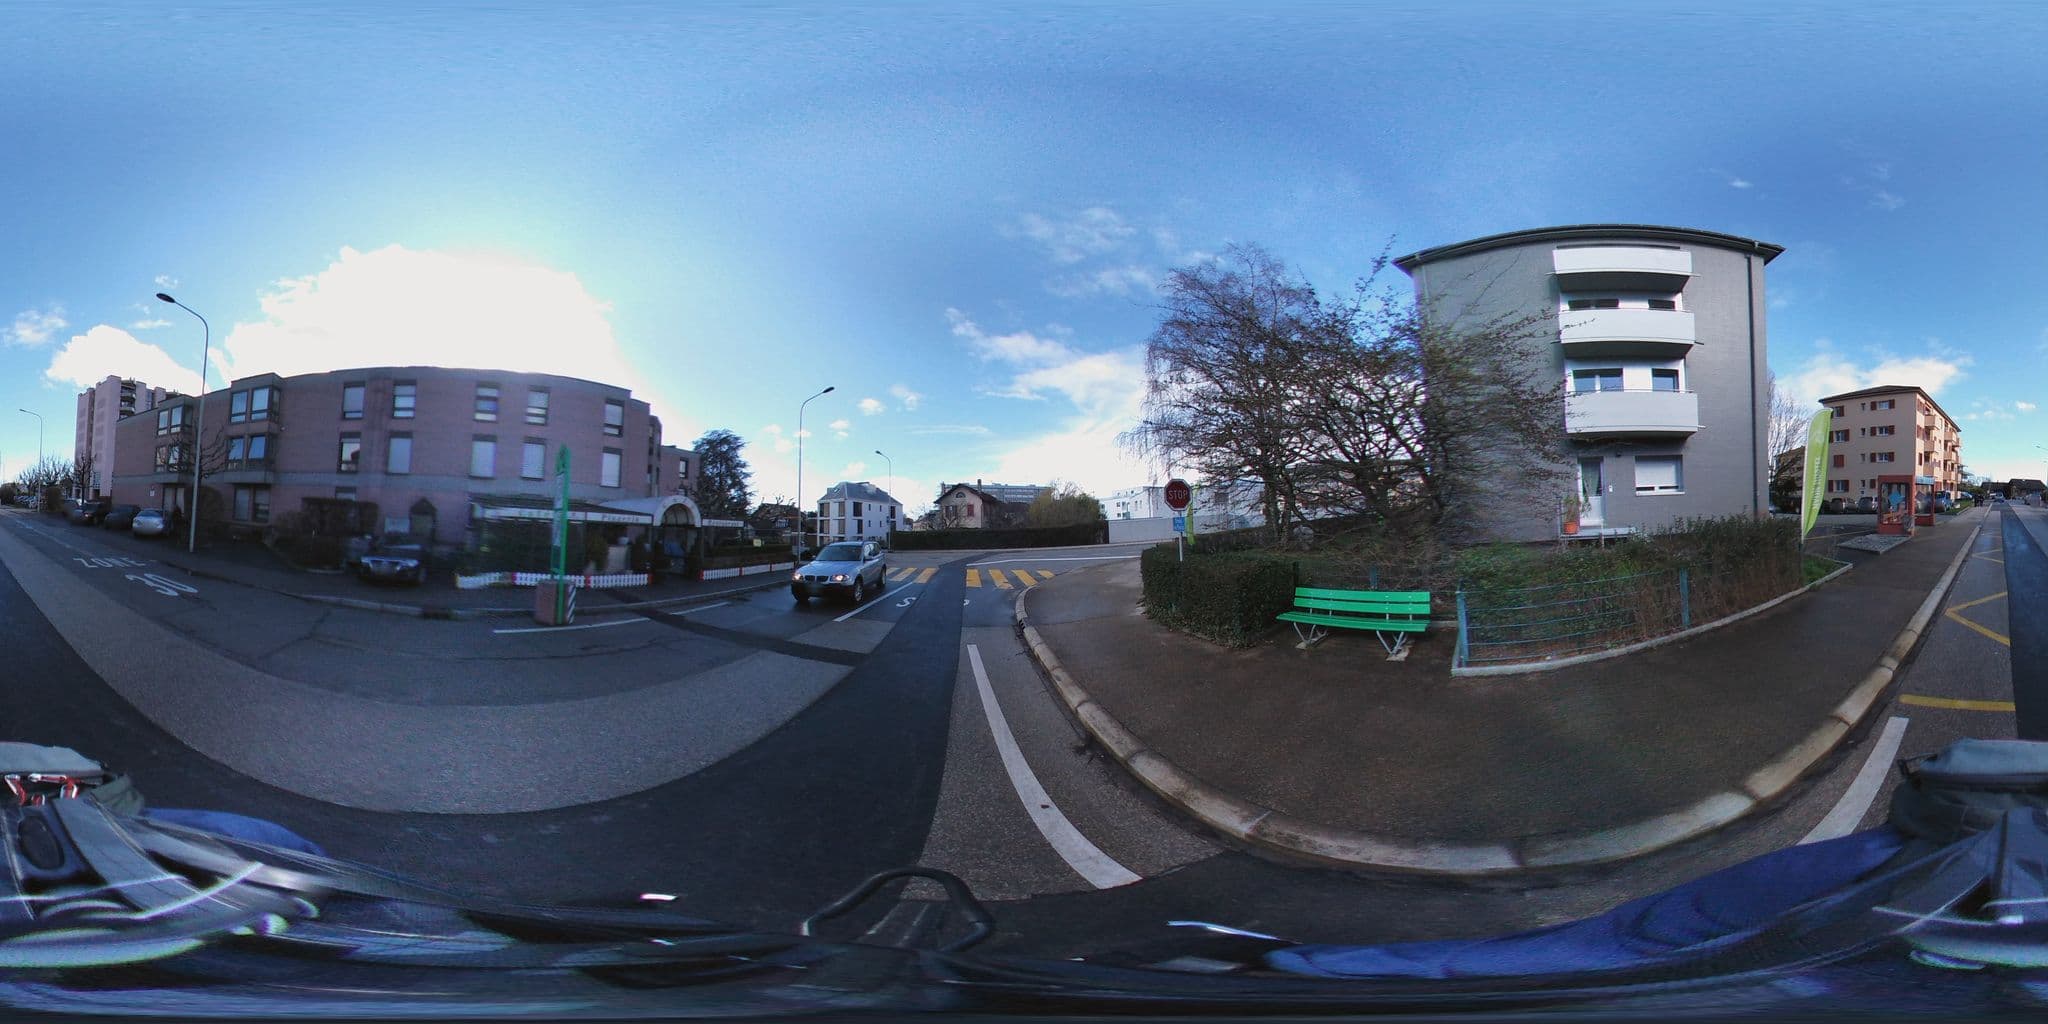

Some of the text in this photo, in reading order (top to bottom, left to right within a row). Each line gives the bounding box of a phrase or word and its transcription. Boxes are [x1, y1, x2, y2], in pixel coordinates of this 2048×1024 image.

[1168, 490, 1187, 500] STOP
[72, 557, 146, 568] ZONE
[125, 573, 198, 596] 30
